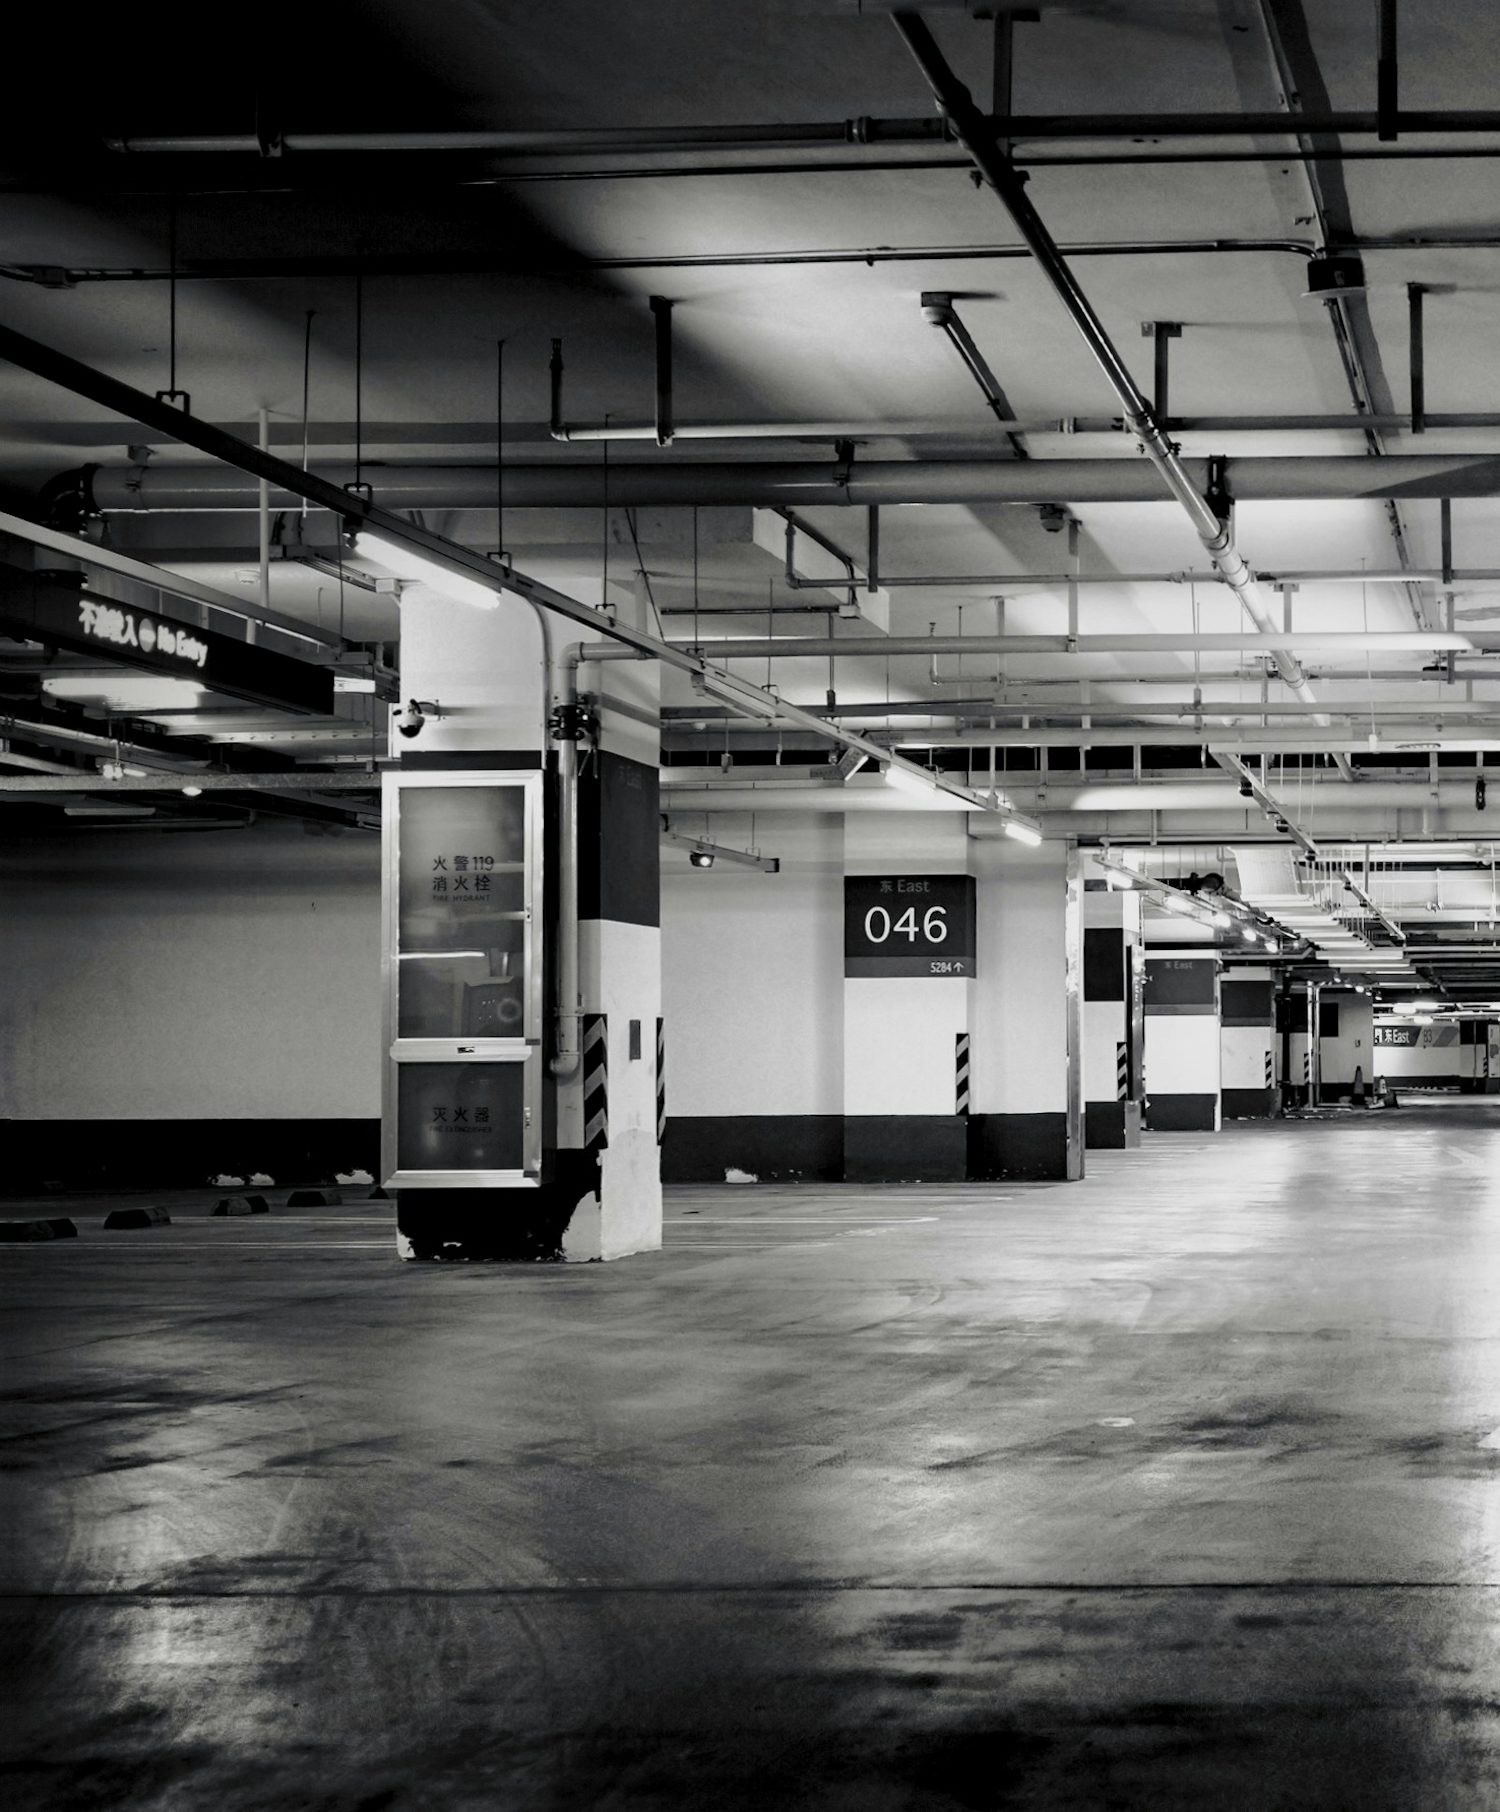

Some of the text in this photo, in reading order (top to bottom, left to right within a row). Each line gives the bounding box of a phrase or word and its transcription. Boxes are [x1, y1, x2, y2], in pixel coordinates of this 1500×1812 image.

[433, 875, 491, 892] 消火栓
[880, 879, 931, 894] 东 East
[864, 906, 948, 943] 046
[930, 962, 952, 973] 5284
[1174, 961, 1193, 969] East
[1393, 1029, 1410, 1043] East
[433, 1107, 489, 1122] 灭火器
